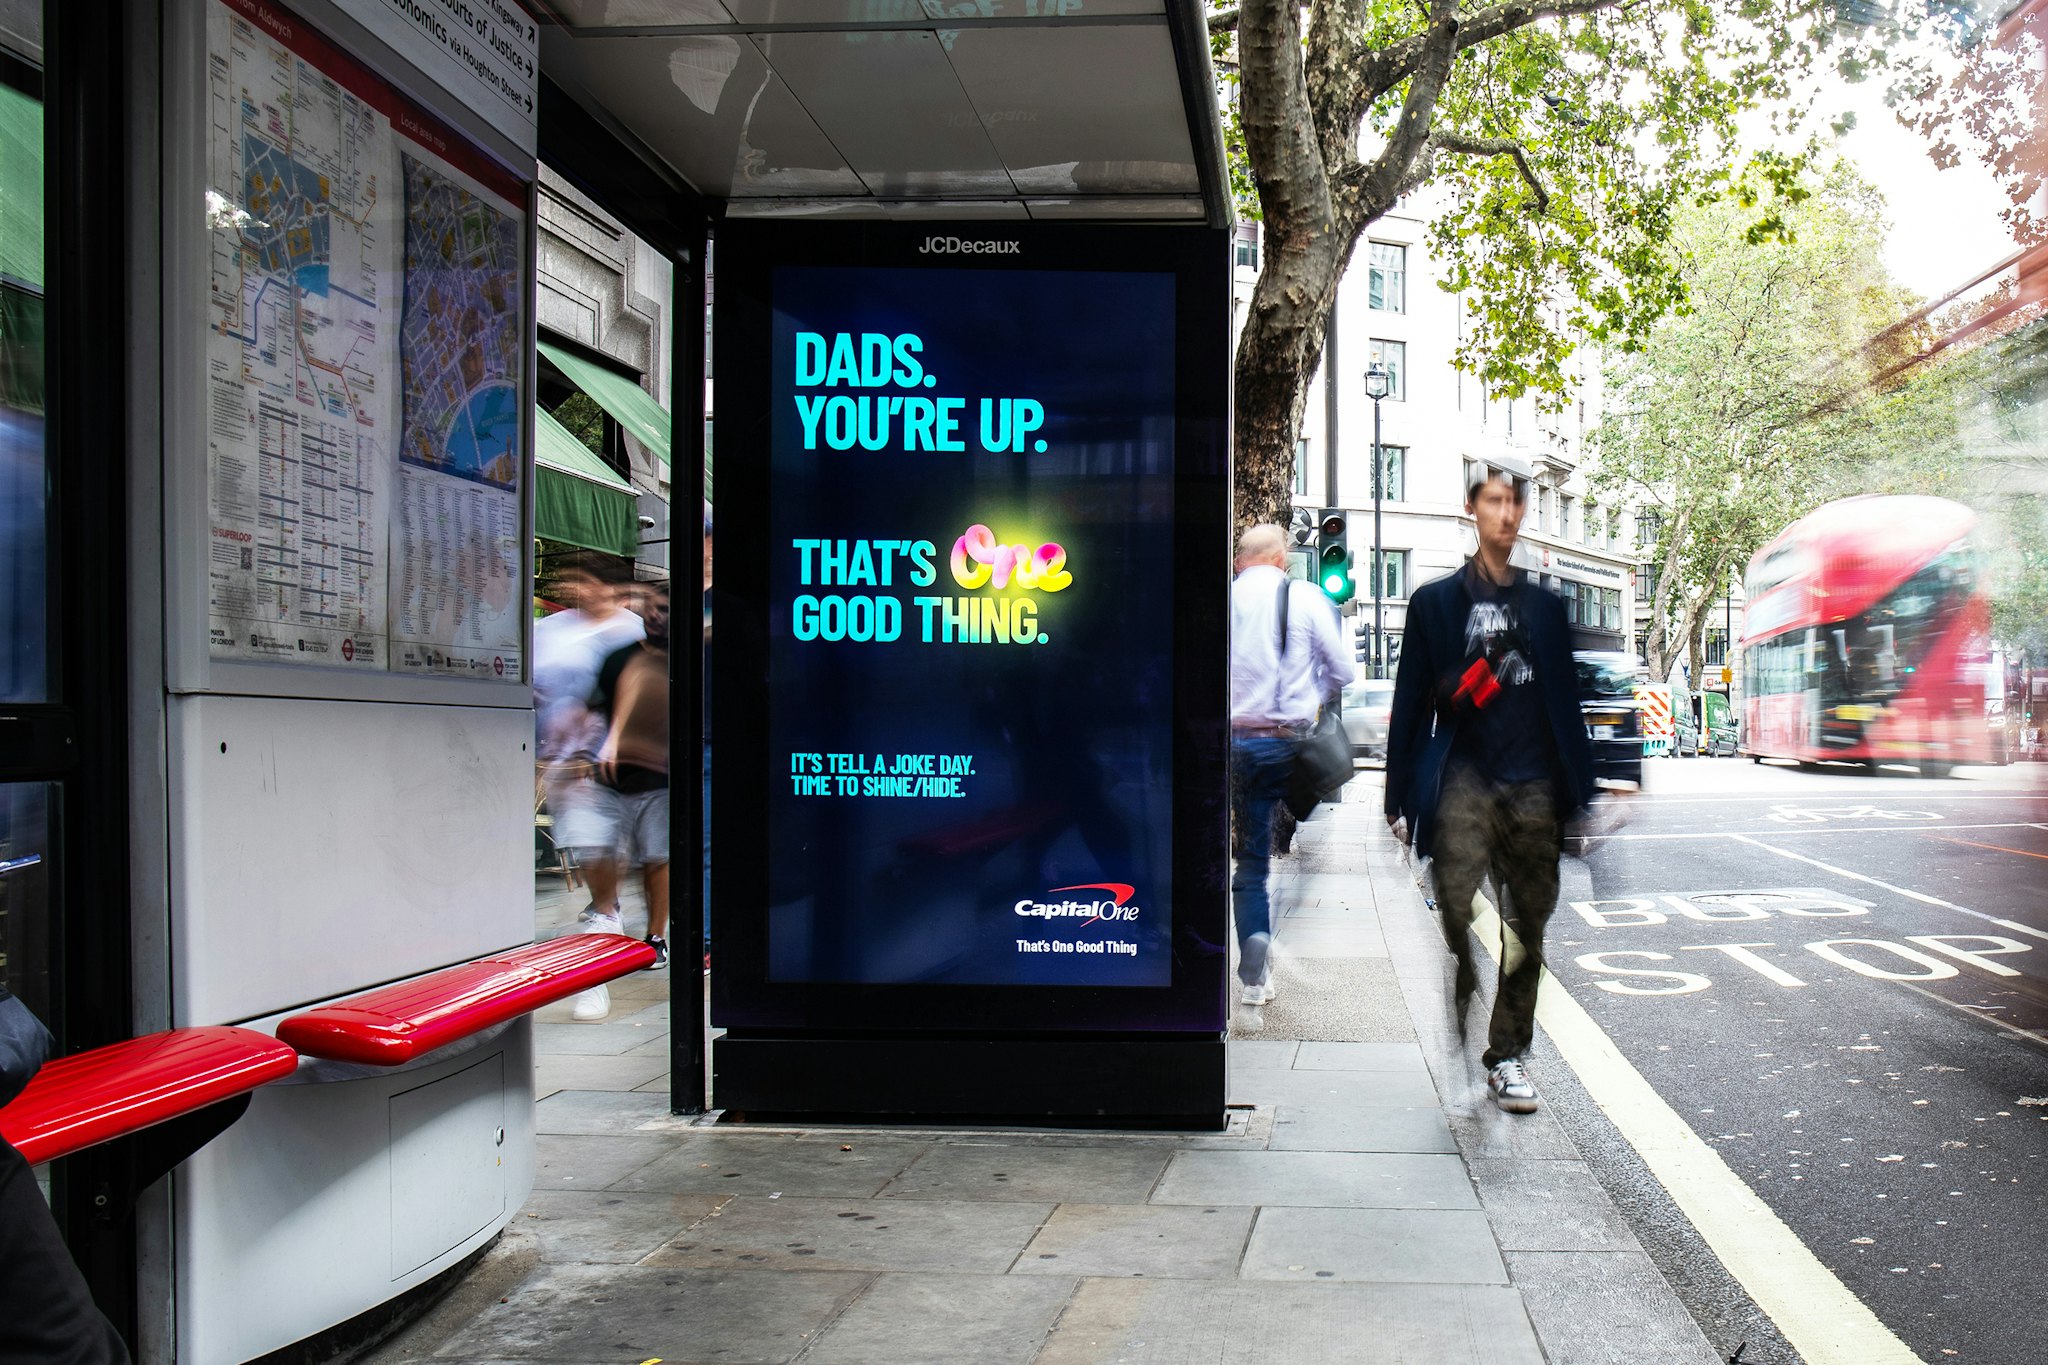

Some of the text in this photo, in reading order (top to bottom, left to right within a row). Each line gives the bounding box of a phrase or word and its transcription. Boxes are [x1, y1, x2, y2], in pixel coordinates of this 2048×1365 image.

[237, 0, 292, 40] rom Aldwych
[491, 0, 524, 39] Kingsway
[476, 18, 488, 39] of
[489, 27, 523, 71] Justice
[450, 38, 461, 56] via
[463, 45, 500, 88] Houghton
[501, 77, 523, 107] Street
[401, 113, 418, 134] Local
[918, 236, 1021, 254] JCDecaux
[795, 331, 937, 388] DADS.
[794, 395, 1048, 453] YOU'RE UP.
[218, 528, 252, 543] SUPERLOOP
[793, 523, 1073, 592] THAT'S One
[793, 594, 1049, 645] GOOD THING.
[791, 753, 976, 776] IT'S TELL A JOKE DAY.
[791, 775, 966, 798] TIME TO SHINE/HIDE.
[1016, 939, 1137, 957] That's One Good Thing
[1574, 935, 2033, 996] STOP
